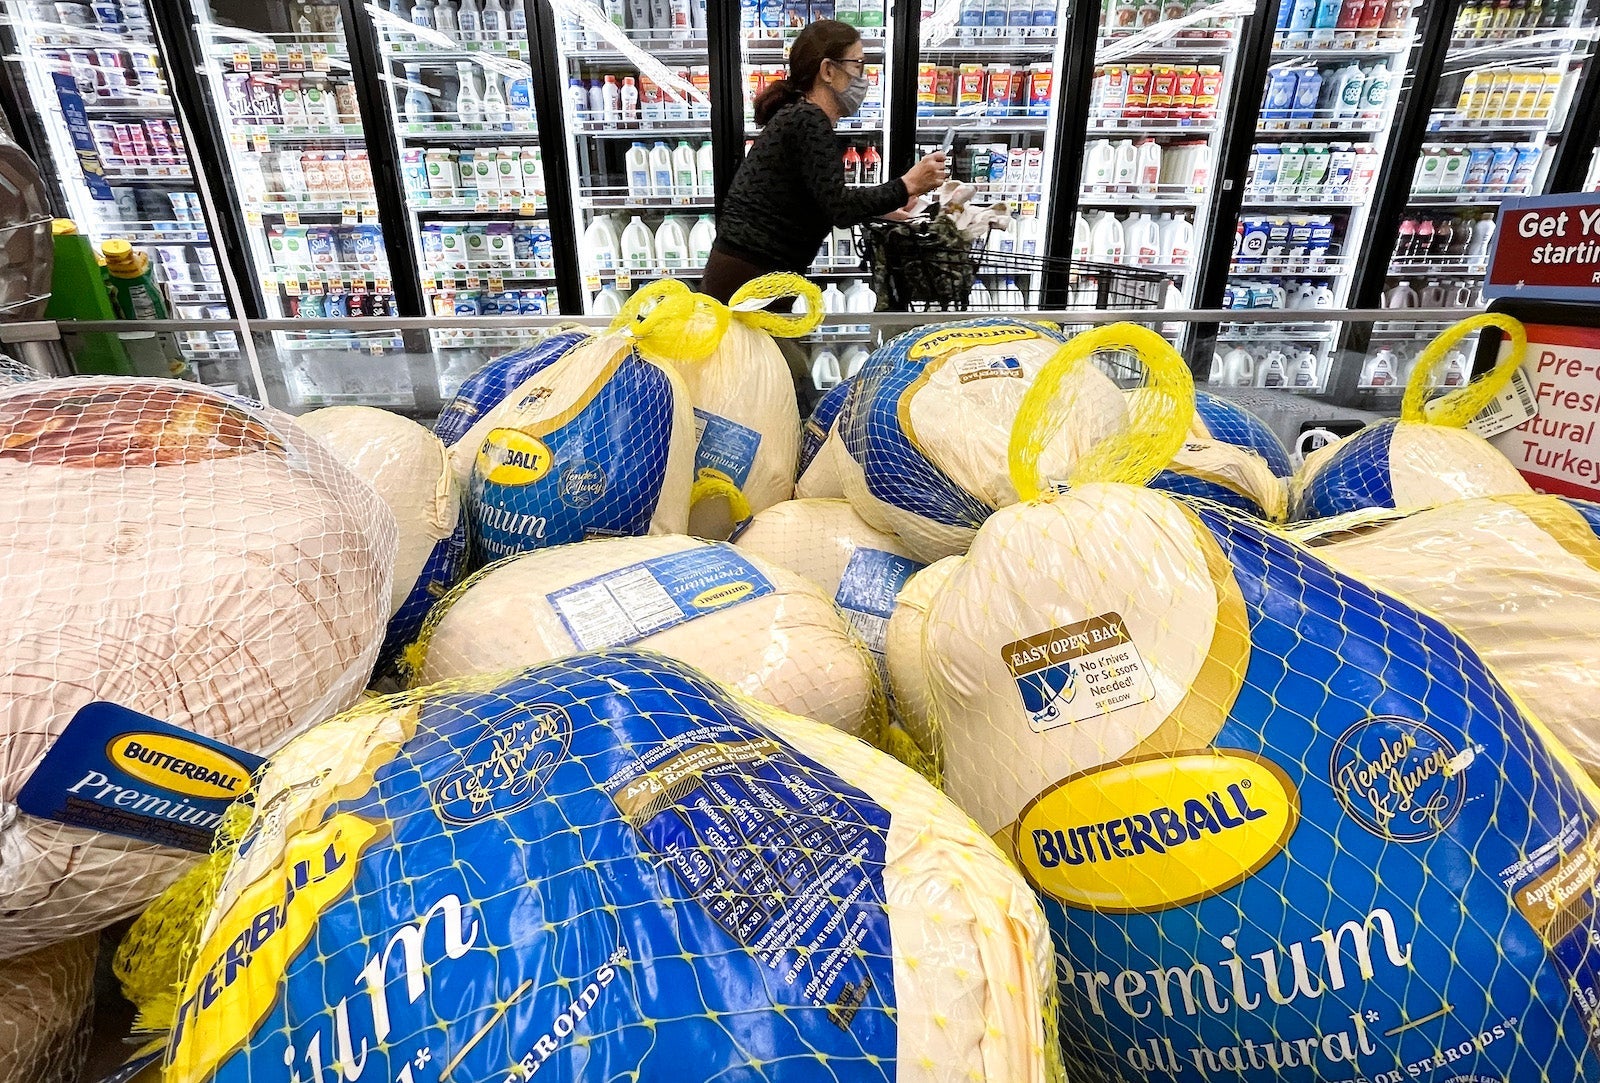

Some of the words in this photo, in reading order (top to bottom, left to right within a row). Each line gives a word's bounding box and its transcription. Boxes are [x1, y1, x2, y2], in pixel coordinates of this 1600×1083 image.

[227, 99, 253, 116] Silk
[252, 98, 277, 115] Silk
[1518, 211, 1569, 238] Get
[312, 238, 328, 250] Silk
[356, 238, 373, 250] Silk
[1248, 239, 1261, 249] a2
[1537, 351, 1600, 379] Pre-
[1515, 416, 1596, 445] atural
[564, 469, 599, 481] Tender
[699, 450, 746, 475] Premium
[572, 481, 604, 495] Juicy
[672, 566, 745, 595] Premium
[698, 584, 750, 605] BUTTERBALL
[1010, 645, 1048, 668] EASY
[1050, 631, 1089, 656] OPEN
[1080, 660, 1097, 673] No
[1097, 650, 1130, 668] Knives
[1085, 672, 1100, 685] Or
[1089, 676, 1135, 697] Needed!
[1107, 692, 1131, 706] BELOW
[122, 741, 237, 792] BUTTERBALL
[441, 720, 526, 801] Tender
[469, 779, 494, 814] &
[493, 709, 564, 790] Juicy
[662, 754, 726, 786] Roasting
[1338, 732, 1416, 798] Tender
[1367, 788, 1396, 826] &
[1388, 747, 1449, 812] Juicy
[694, 797, 722, 827] people)
[1031, 782, 1267, 868] BUTTERBALL
[747, 821, 758, 833] In
[731, 850, 750, 867] 6-12
[758, 825, 775, 842] 3-4
[741, 862, 762, 881] 12-15
[793, 822, 809, 835] 9-11
[780, 849, 798, 866] 5-6
[803, 832, 823, 848] 11-12
[689, 850, 712, 878] (lbs)
[738, 910, 762, 938] 24-30
[792, 862, 808, 879] 6-7
[812, 843, 832, 862] 12-15
[1525, 852, 1588, 907] Approximate
[803, 898, 829, 930] minutes
[758, 951, 770, 963] in
[794, 910, 805, 924] or
[784, 968, 796, 985] DO
[792, 957, 808, 975] NOT
[816, 930, 828, 943] AT
[824, 970, 839, 992] rack
[833, 960, 843, 973] in
[1126, 1037, 1184, 1075] all
[1187, 1009, 1381, 1076] natural
